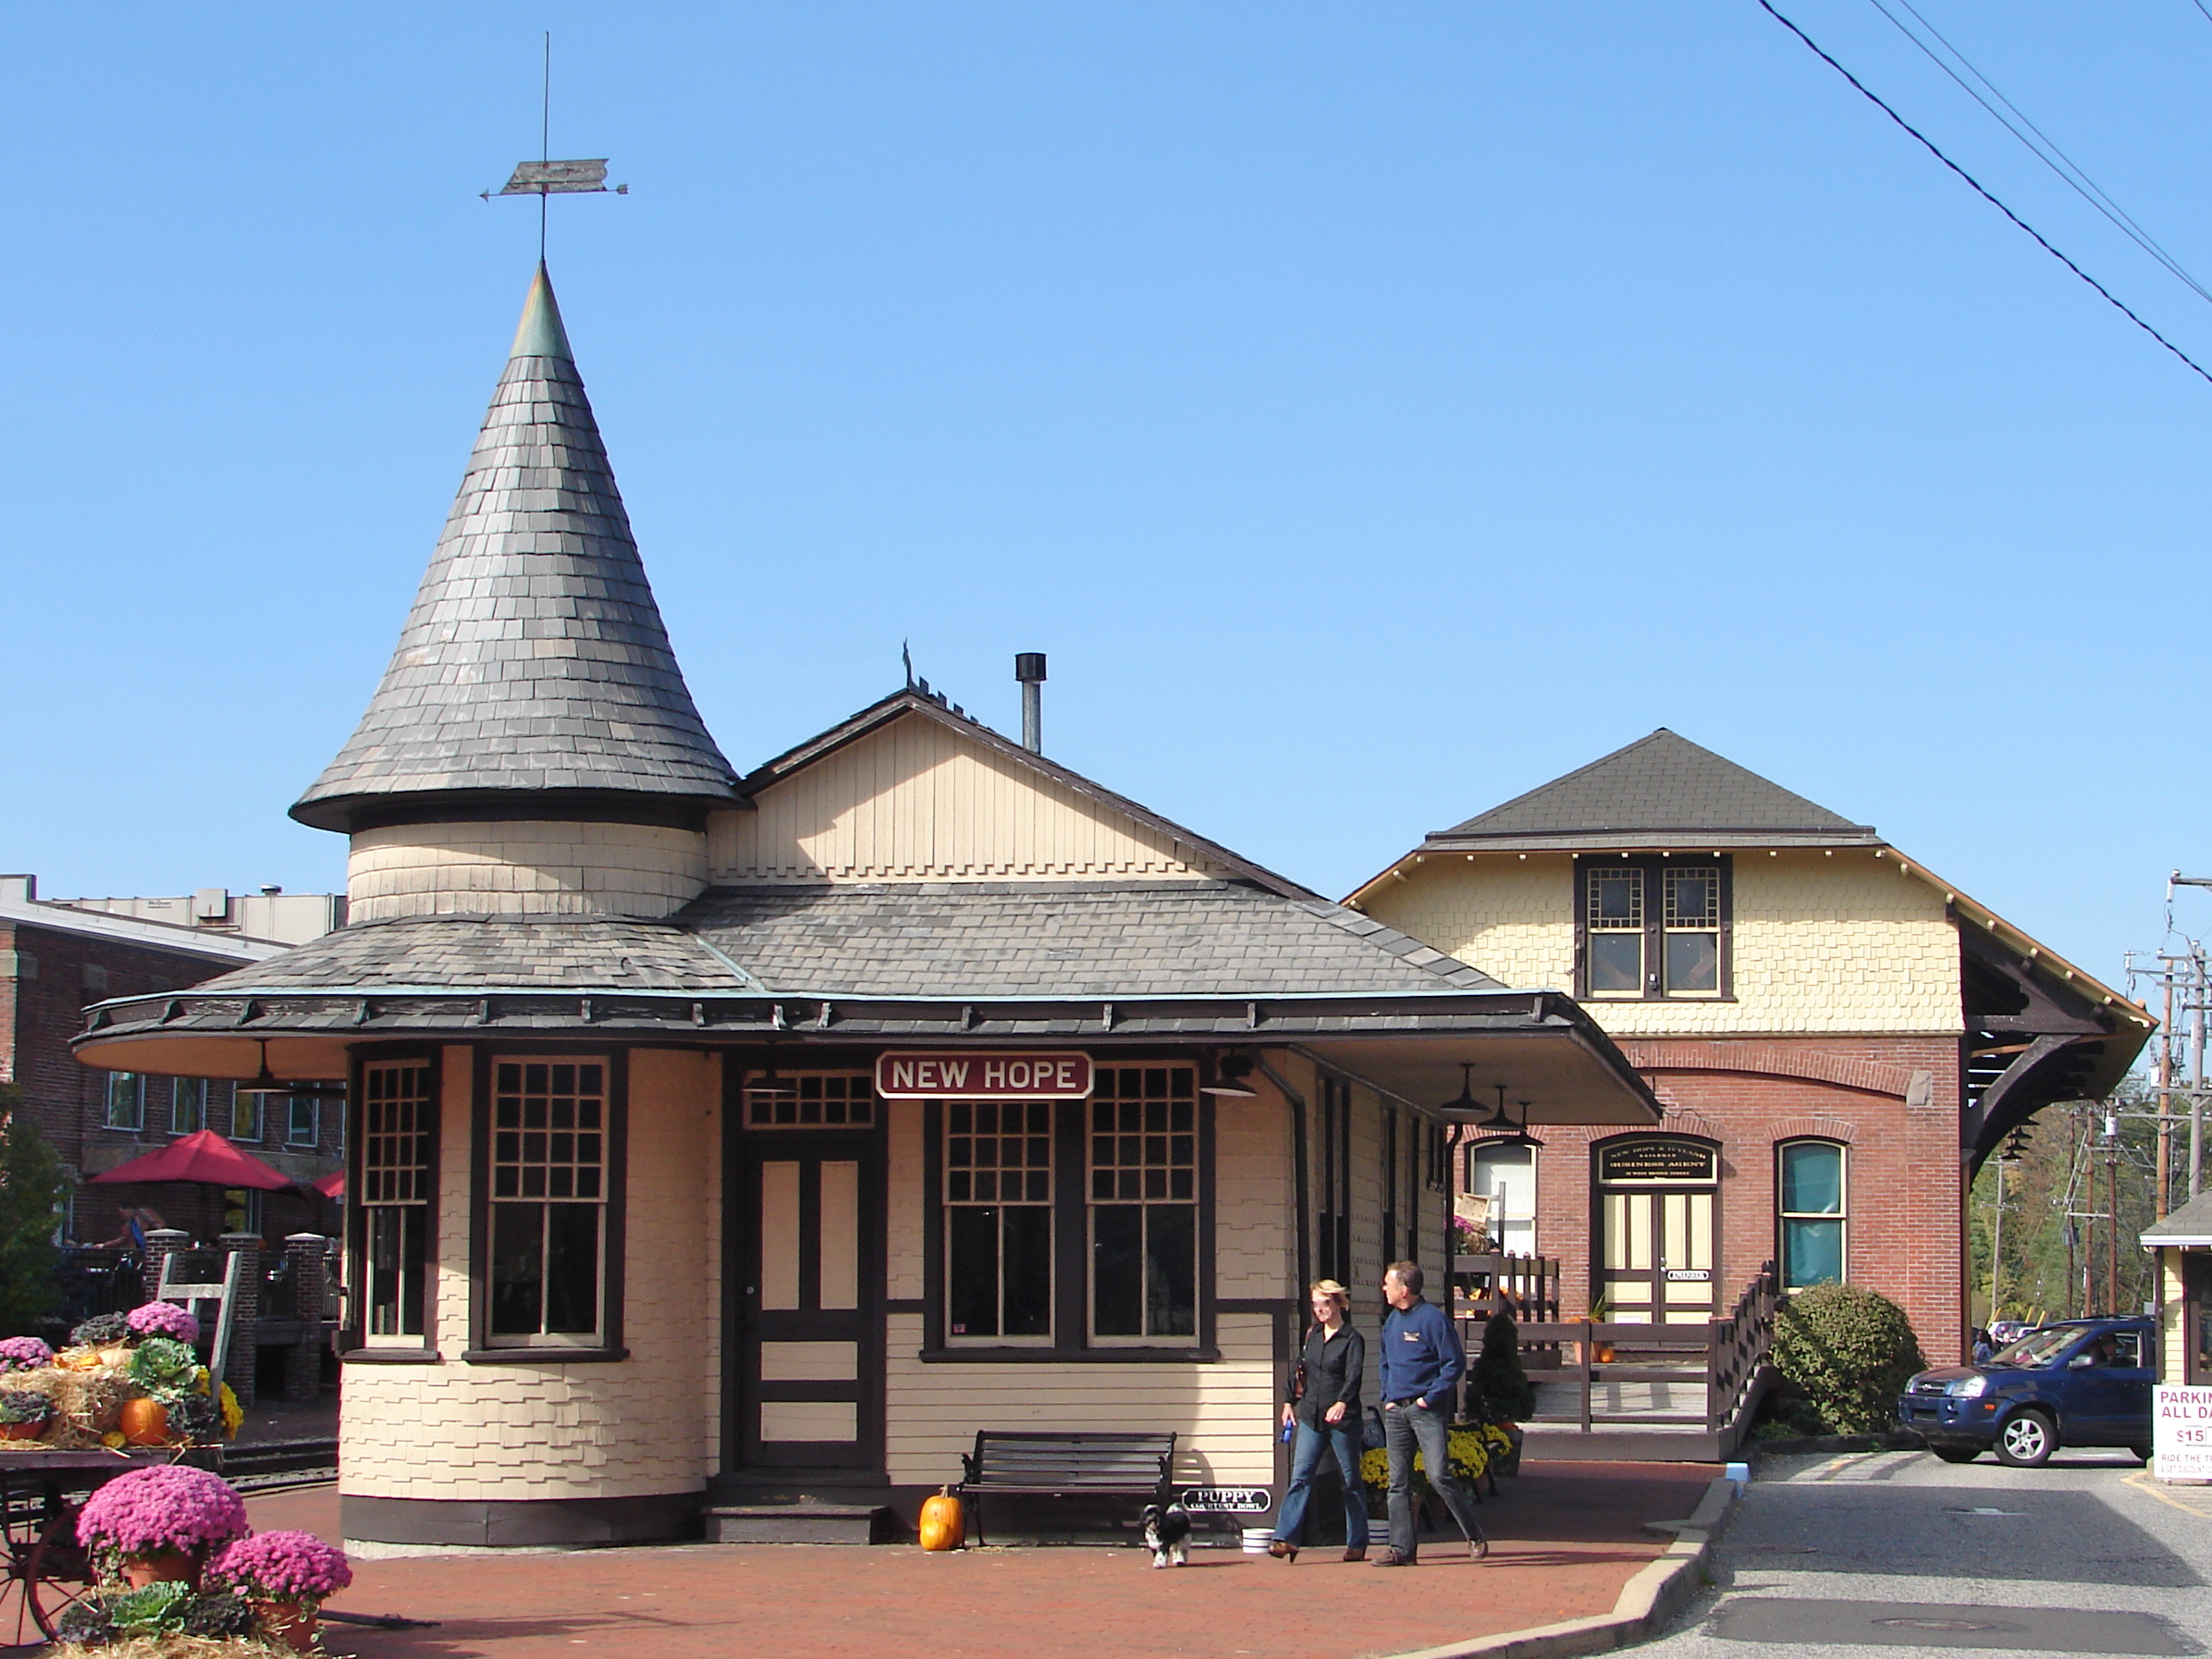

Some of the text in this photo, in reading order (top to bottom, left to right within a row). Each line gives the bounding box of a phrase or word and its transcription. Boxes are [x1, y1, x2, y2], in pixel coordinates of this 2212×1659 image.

[892, 1061, 1077, 1088] NEW HOPE
[2161, 1406, 2192, 1419] ALL
[2177, 1430, 2205, 1443] $15
[2161, 1454, 2181, 1462] RIDE
[2184, 1454, 2201, 1462] THE
[1198, 1492, 1255, 1503] PUPPY
